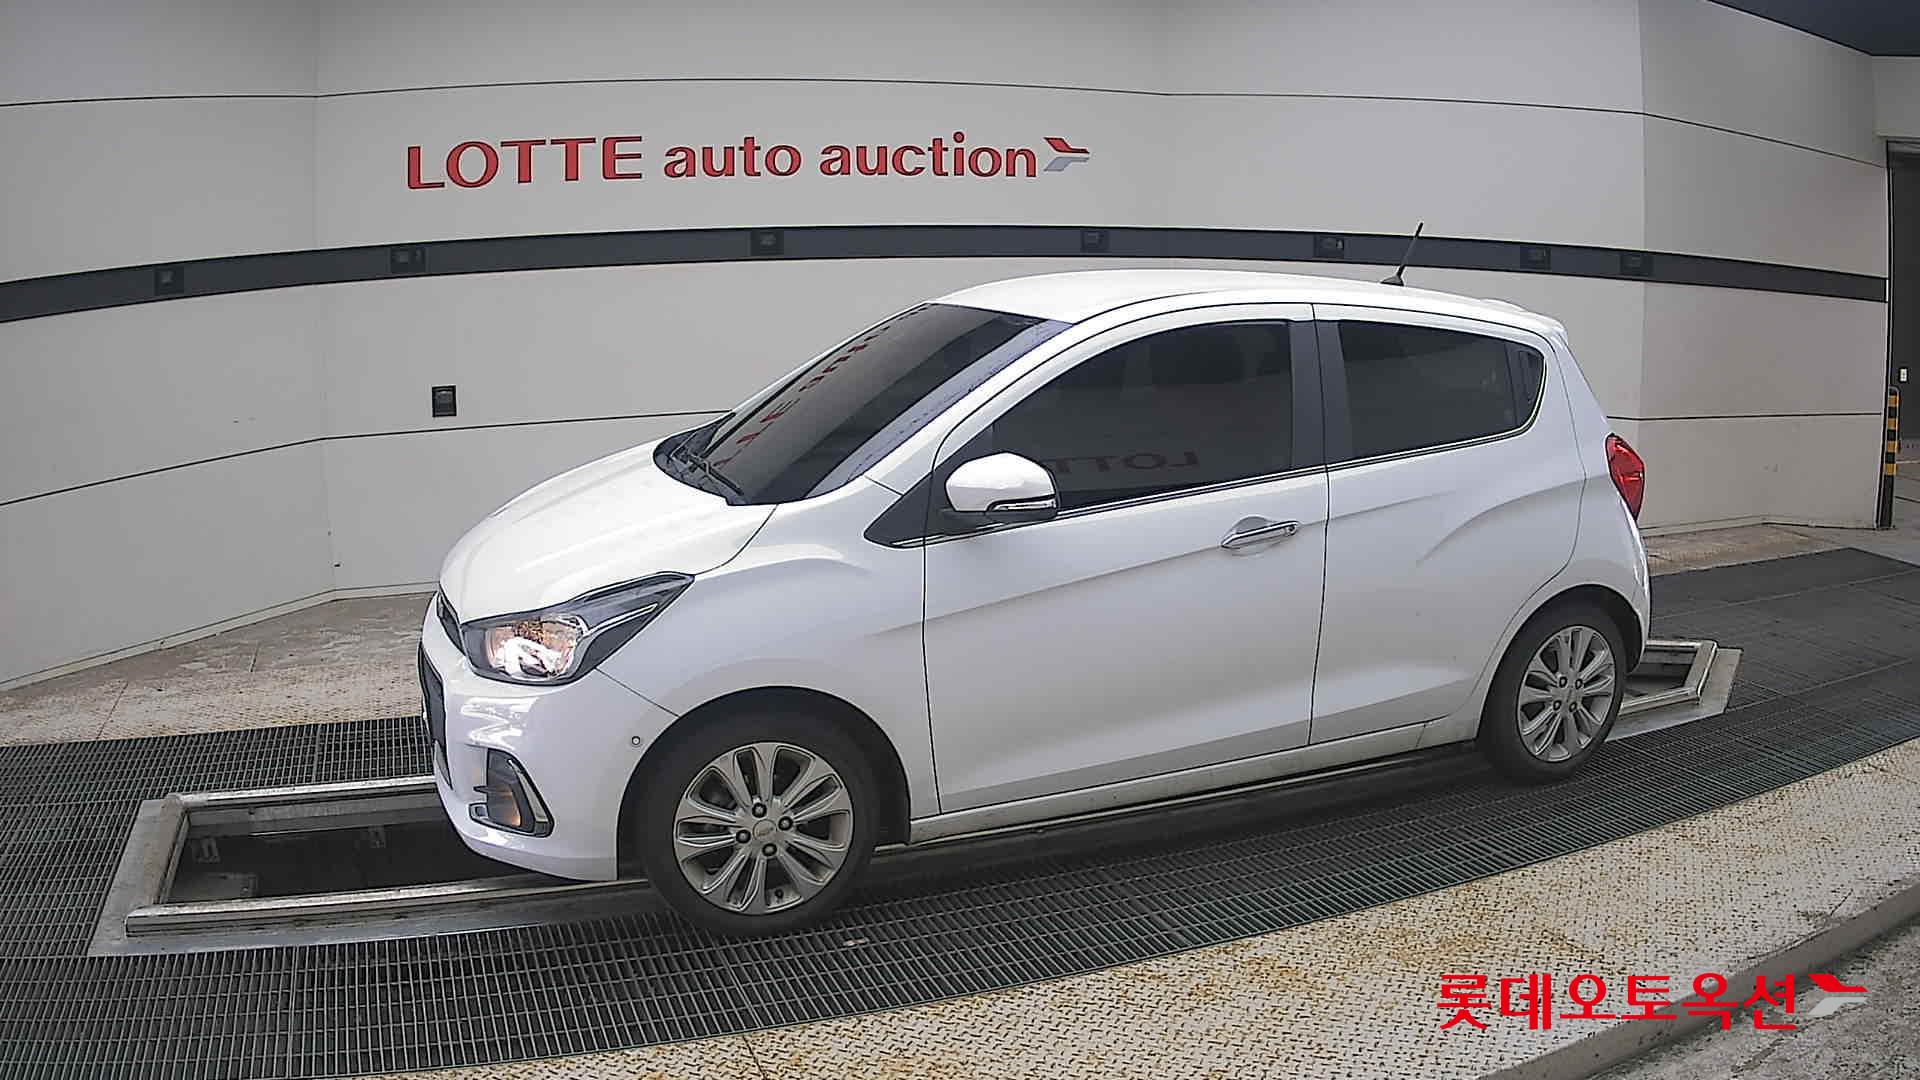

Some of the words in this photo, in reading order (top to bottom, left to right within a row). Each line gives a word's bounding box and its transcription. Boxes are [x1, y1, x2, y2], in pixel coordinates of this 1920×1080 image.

[407, 136, 643, 190] LOTTE
[664, 136, 802, 178] auto
[820, 132, 1038, 178] auction
